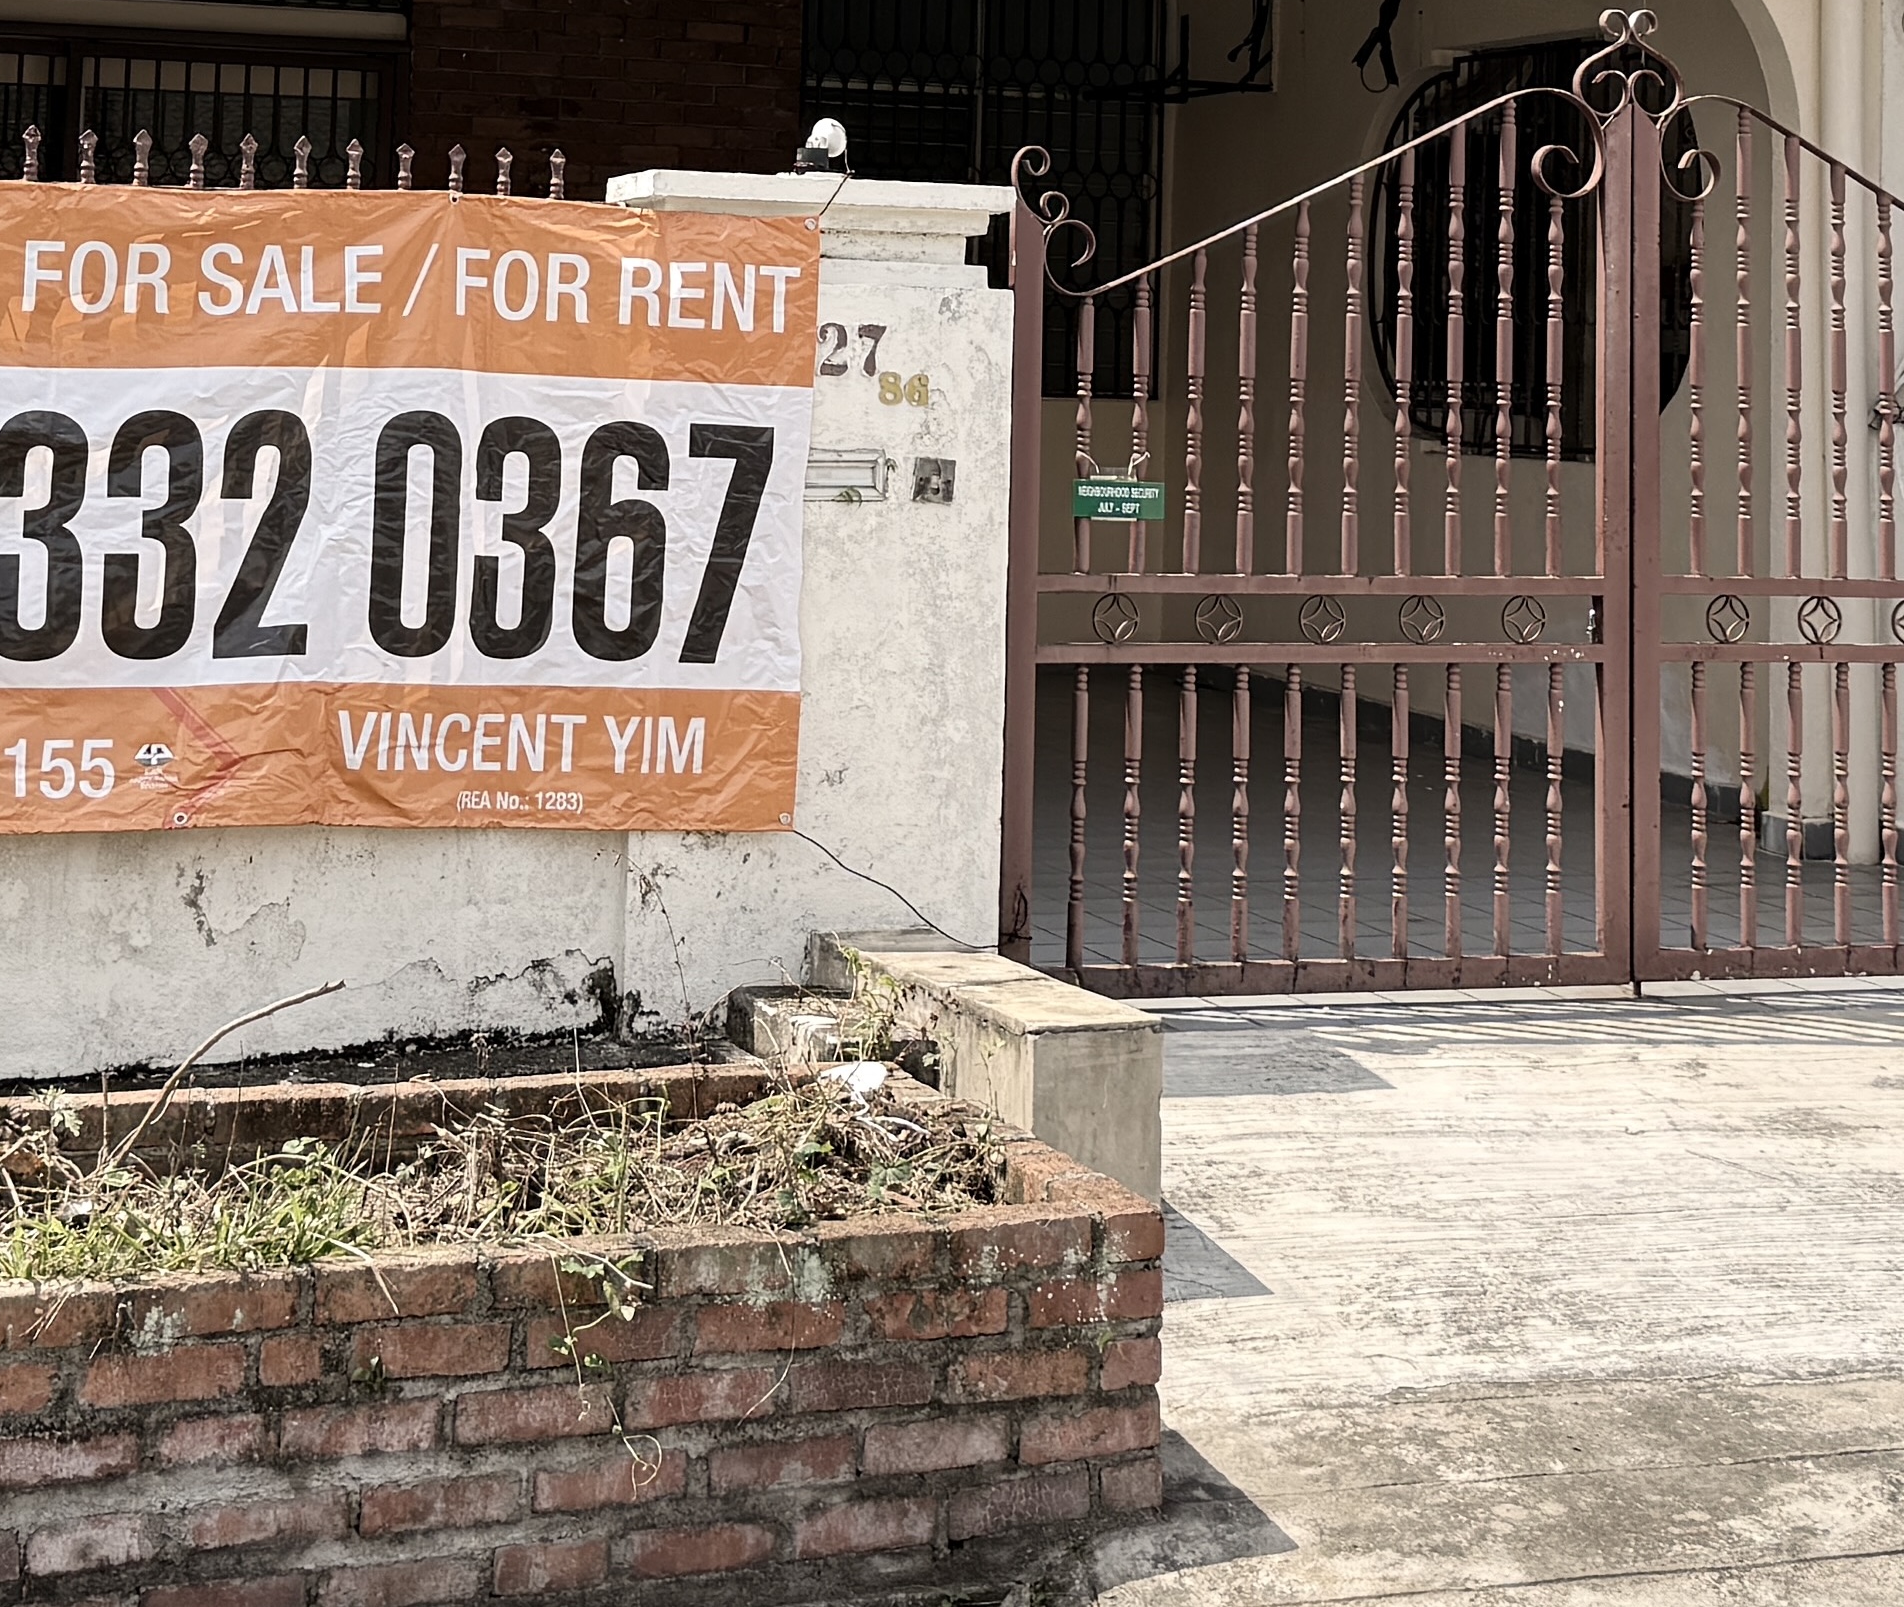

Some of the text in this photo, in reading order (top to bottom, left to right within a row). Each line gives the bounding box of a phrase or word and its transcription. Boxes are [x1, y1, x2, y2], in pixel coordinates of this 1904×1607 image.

[21, 239, 171, 316] FOR
[198, 241, 382, 315] SALE
[617, 257, 801, 334] RENT
[817, 322, 887, 377] 27
[878, 371, 930, 407] 86
[1097, 501, 1114, 513] JULY
[1121, 502, 1140, 514] SEPT
[1130, 487, 1159, 499] SECURITY
[368, 409, 775, 665] 0367
[337, 709, 707, 775] VINCENT YIM
[456, 790, 583, 814] (REA No.: 1283)
